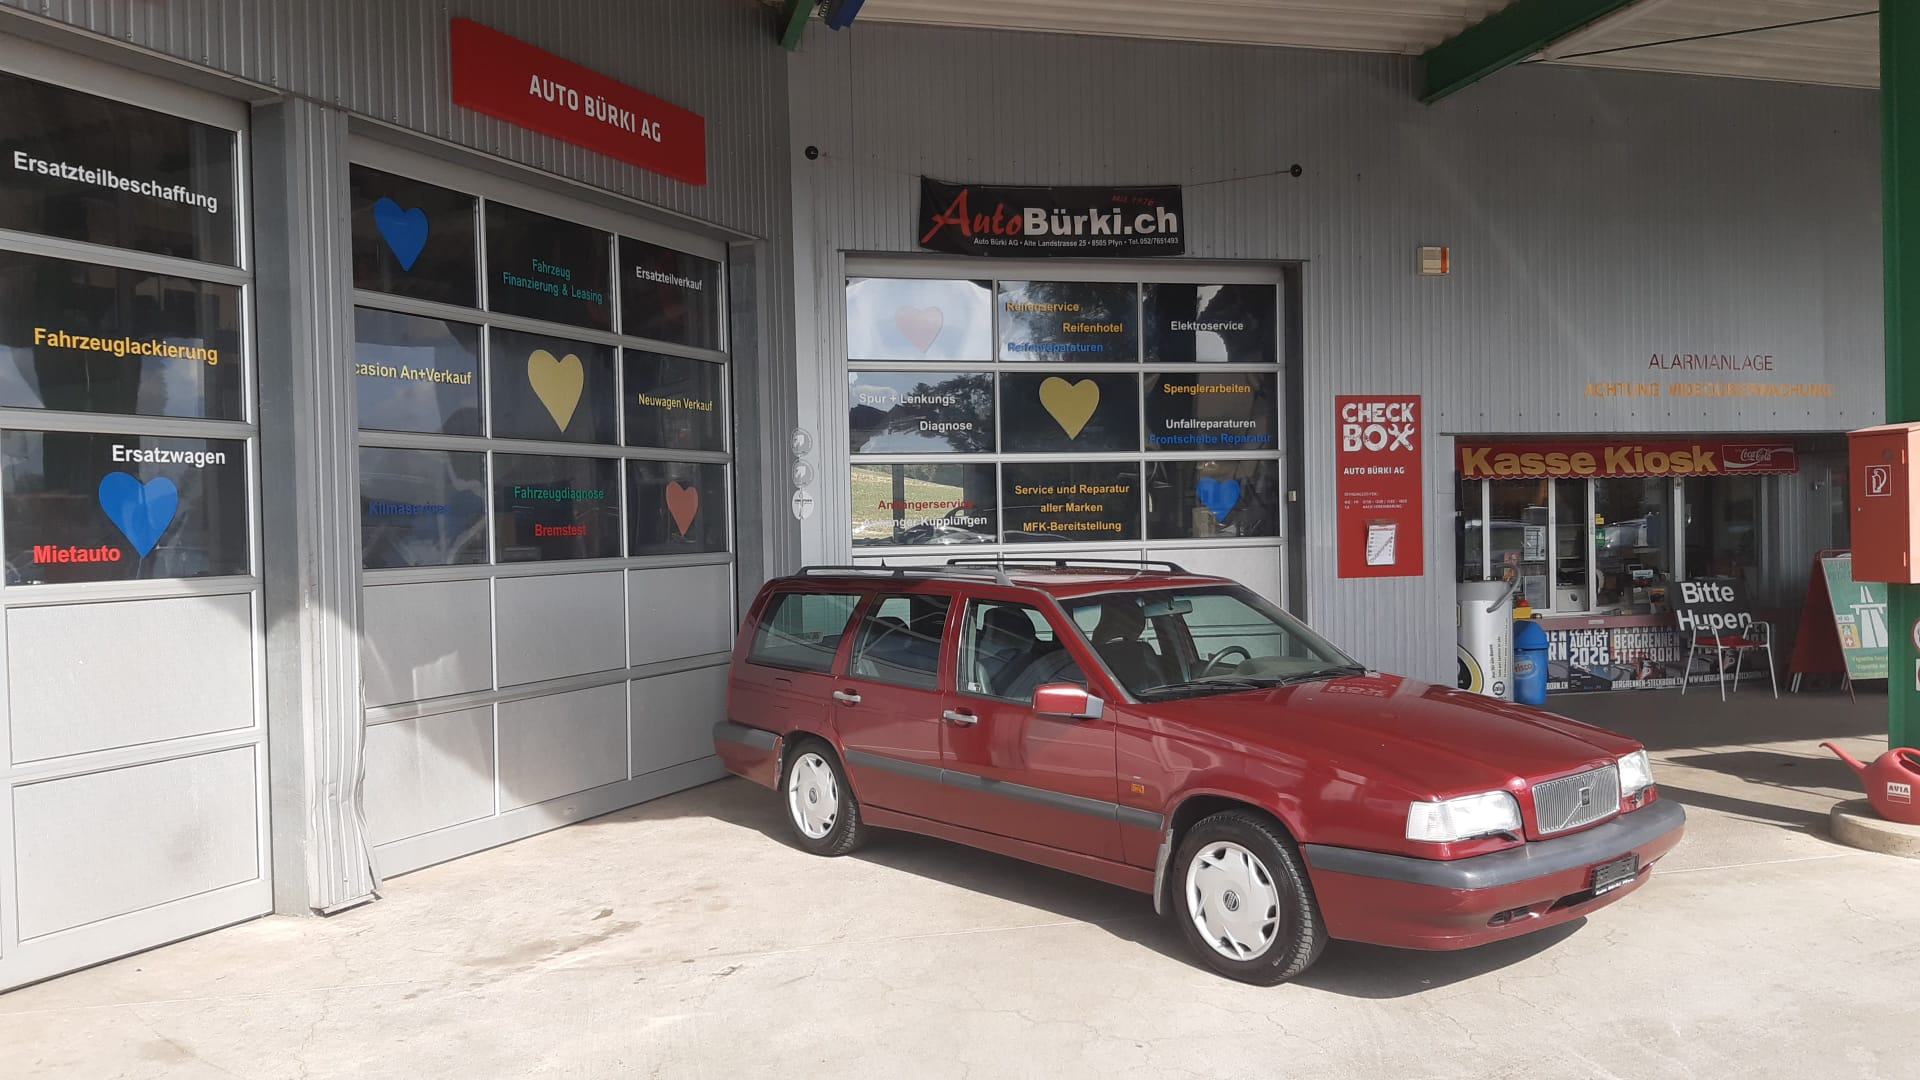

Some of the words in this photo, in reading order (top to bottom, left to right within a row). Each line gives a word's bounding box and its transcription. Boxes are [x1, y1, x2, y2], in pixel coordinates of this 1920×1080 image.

[529, 74, 579, 111] AUTO
[585, 96, 636, 133] BÜRKI
[641, 118, 662, 143] AG
[13, 151, 218, 214] Ersatzteilbeschaffung
[973, 237, 989, 246] Auto
[1008, 239, 1019, 247] AG
[1037, 240, 1078, 248] Landstrasse
[1079, 239, 1087, 247] 25
[532, 258, 571, 280] Fahrzeug
[636, 266, 703, 291] Ersatzteilverkauf
[503, 271, 559, 296] Finanzierung
[562, 283, 568, 296] &
[571, 285, 603, 305] Leasing
[1062, 322, 1123, 333] Reifenhotel
[1170, 320, 1244, 332] Elektroservice
[34, 327, 219, 366] Fahrzeuglackierung
[1648, 353, 1773, 371] ALARMANLAGE
[400, 365, 472, 385] An+Verkauf
[1163, 384, 1251, 395] Spenglerarbeiten
[1584, 383, 1661, 398] ACHTUNG
[638, 393, 681, 411] Neuwagen
[683, 398, 713, 412] Verkauf
[858, 393, 887, 406] Spur
[900, 394, 956, 407] Lenkungs
[1342, 402, 1415, 423] CHECK
[919, 421, 973, 432] Diagnose
[1166, 419, 1256, 430] Unfallreparaturen
[1220, 433, 1272, 444] Reparatur
[1343, 423, 1415, 452] BOX
[111, 444, 226, 468] Ersatzwagen
[1461, 446, 1598, 477] Kasse
[1604, 446, 1718, 474] Kiosk
[1344, 466, 1365, 475] AUTO
[1367, 466, 1391, 474] BÜRKI
[1393, 466, 1405, 474] AG
[514, 486, 605, 503] Fahrzeugdiagnose
[1014, 484, 1054, 495] Service
[1056, 484, 1077, 494] und
[1079, 483, 1130, 496] Reparatur
[878, 500, 975, 511] Anhängerservice
[1040, 503, 1062, 513] aller
[1065, 502, 1103, 513] Marken
[534, 524, 587, 537] Bremstest
[920, 516, 988, 528] Kupplungen
[1023, 521, 1122, 532] MFK-Bereitstellung
[33, 545, 121, 564] Mietauto
[1681, 581, 1735, 604] Bitte
[1676, 609, 1752, 632] Hupen
[1569, 635, 1608, 648] AUGUST
[1614, 632, 1680, 649] BERGRENNEN
[1569, 647, 1609, 666] 2026
[1888, 784, 1910, 794] AVIA
